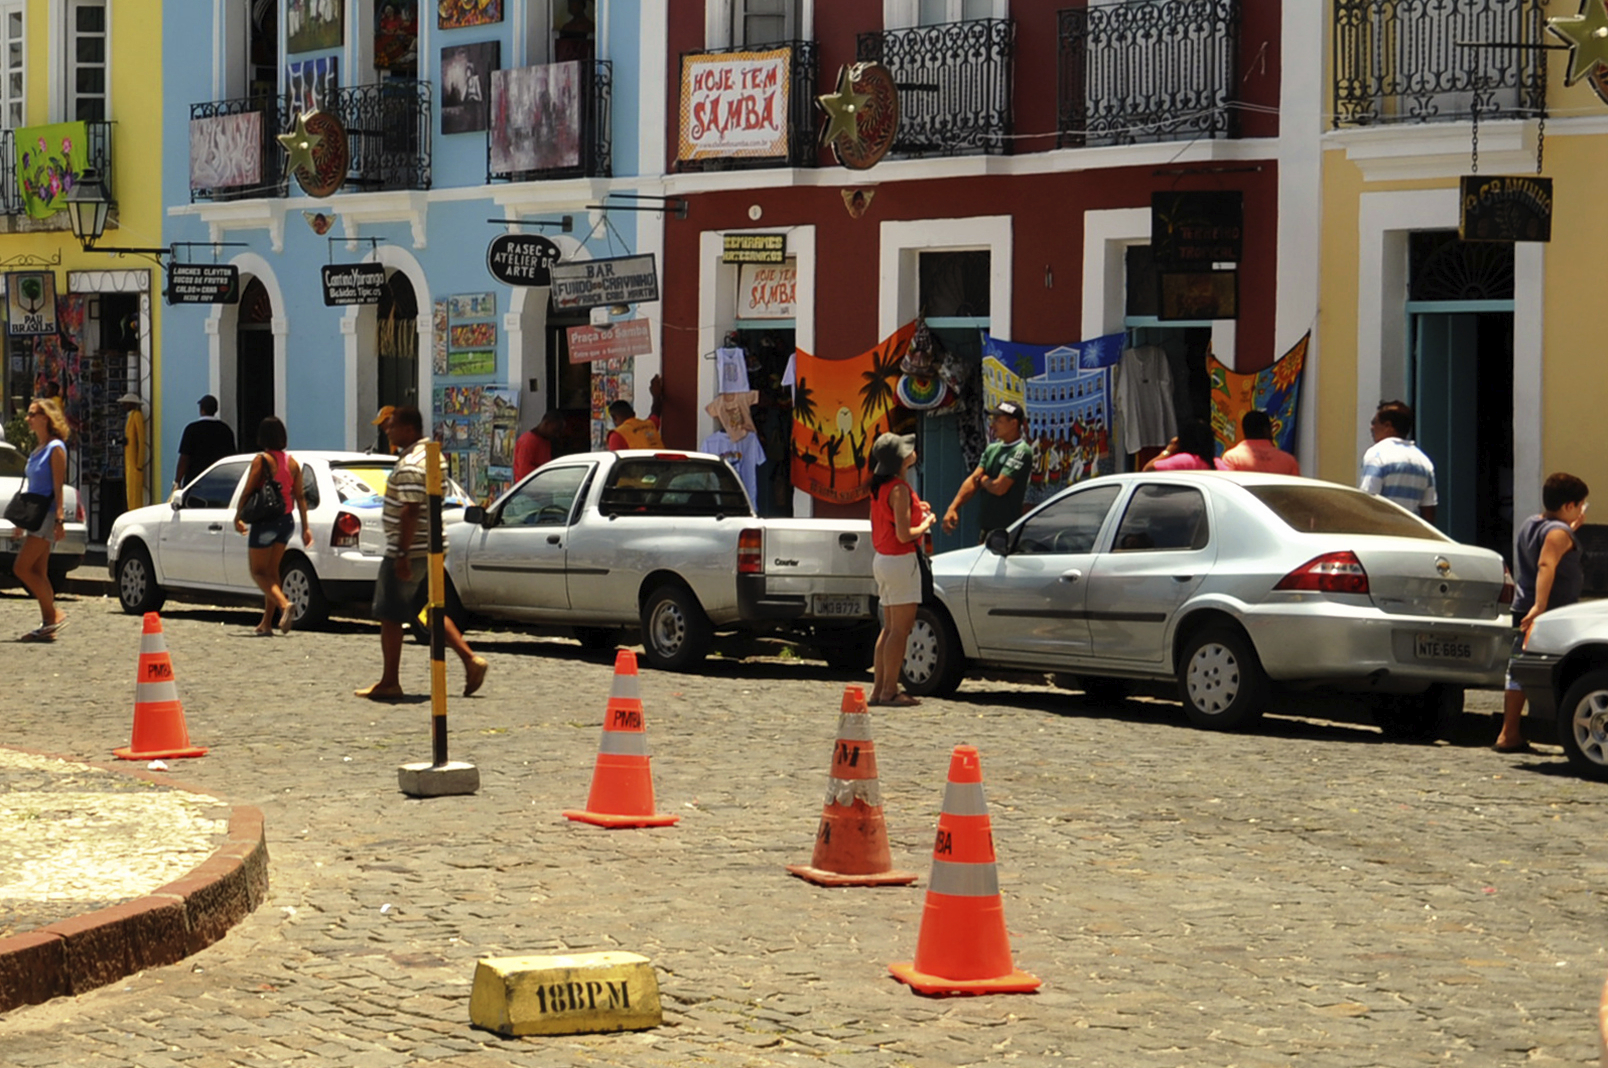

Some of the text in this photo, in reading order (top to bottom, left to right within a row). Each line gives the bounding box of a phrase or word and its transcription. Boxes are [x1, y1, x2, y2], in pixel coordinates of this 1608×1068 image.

[692, 64, 778, 93] HOJE TEM
[691, 90, 779, 140] SAMBA
[507, 242, 543, 257] RASEC
[494, 252, 554, 269] ATELIER DE
[325, 270, 352, 287] Cantina
[505, 267, 535, 278] ARTE
[586, 263, 616, 279] BAR
[753, 269, 776, 284] HOJE
[194, 276, 203, 284] DE
[203, 276, 229, 284] FRUTAS
[557, 280, 593, 297] FUNDO
[602, 273, 654, 292] CRAVINHO
[329, 287, 357, 298] Bebidas
[749, 282, 797, 309] SAMBA
[24, 315, 44, 324] PAU
[12, 323, 54, 333] BRASILIS
[571, 325, 648, 344] Praça do Samba
[774, 558, 800, 567] Courier
[536, 980, 630, 1014] 18BPM
